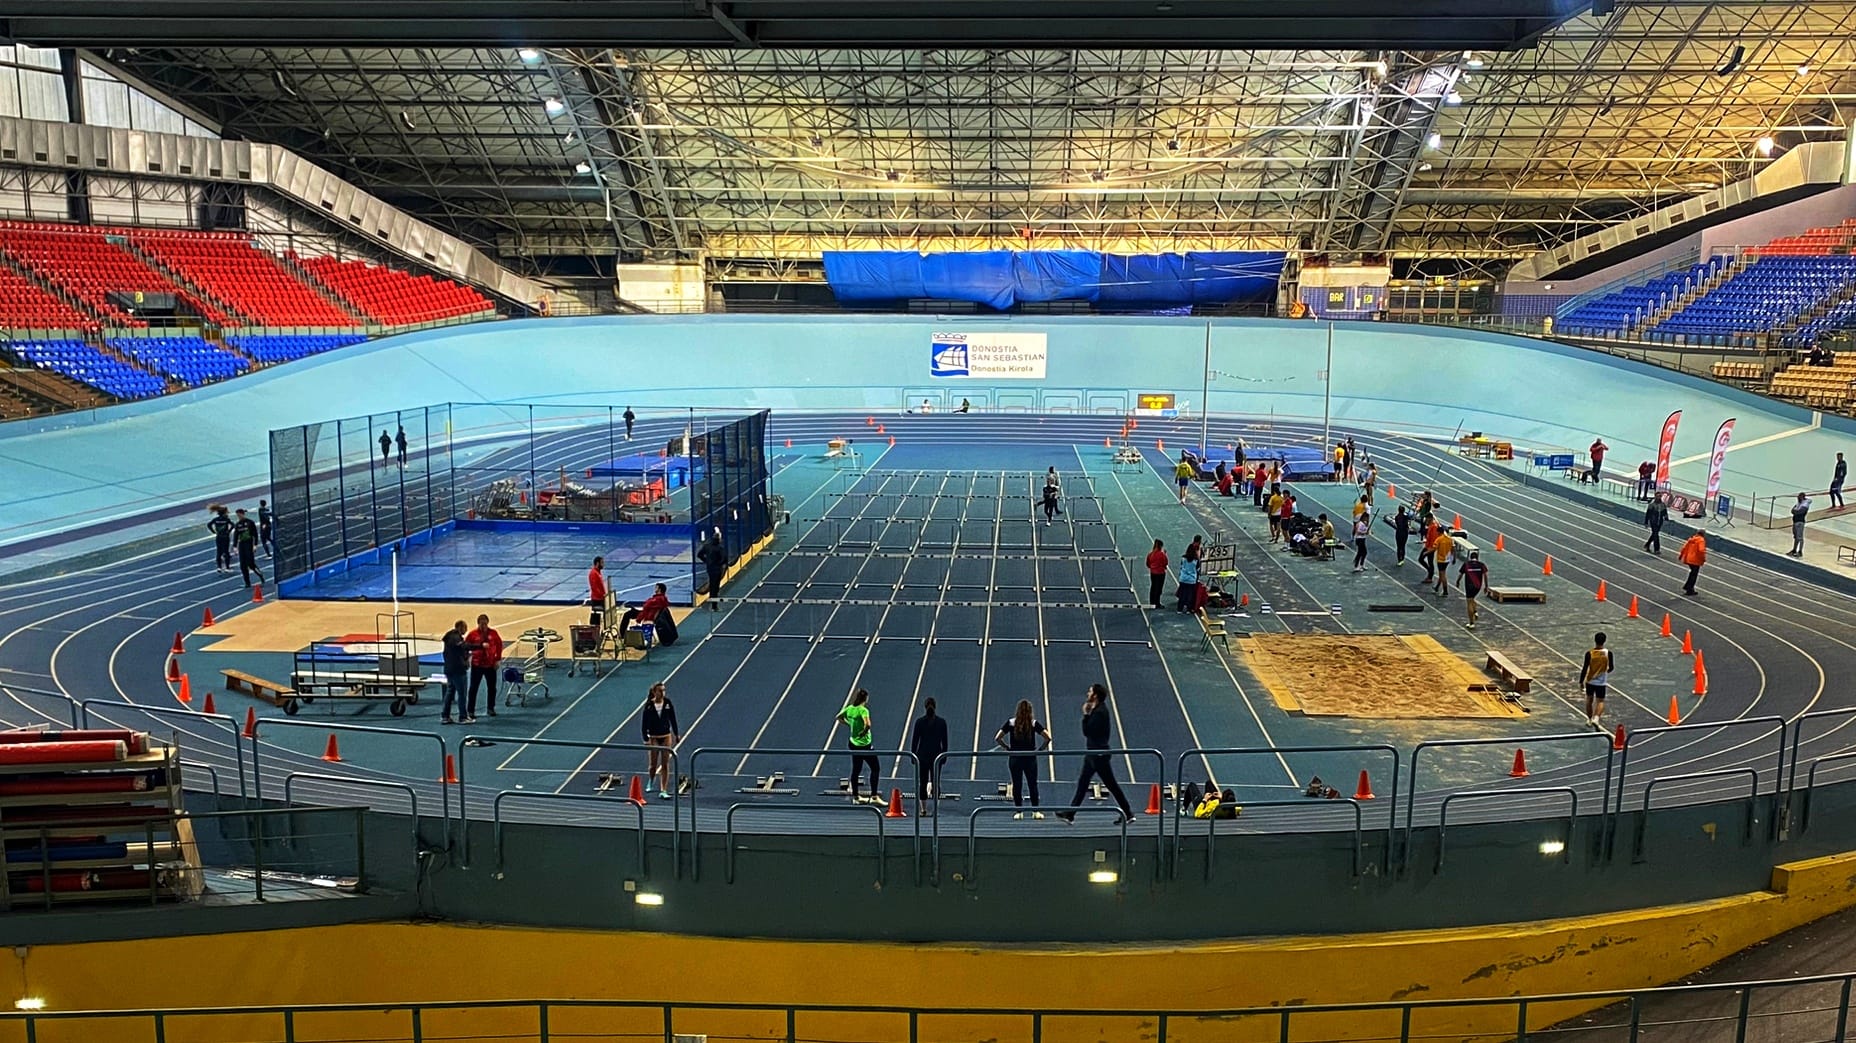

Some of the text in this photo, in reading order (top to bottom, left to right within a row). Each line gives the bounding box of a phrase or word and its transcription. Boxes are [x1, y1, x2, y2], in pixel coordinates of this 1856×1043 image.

[1329, 292, 1344, 302] BAR
[971, 345, 1018, 353] DONOSTIA
[993, 353, 1045, 362] SEBASTIAN
[971, 364, 1034, 372] Donostia Kirola
[1209, 546, 1228, 557] 295
